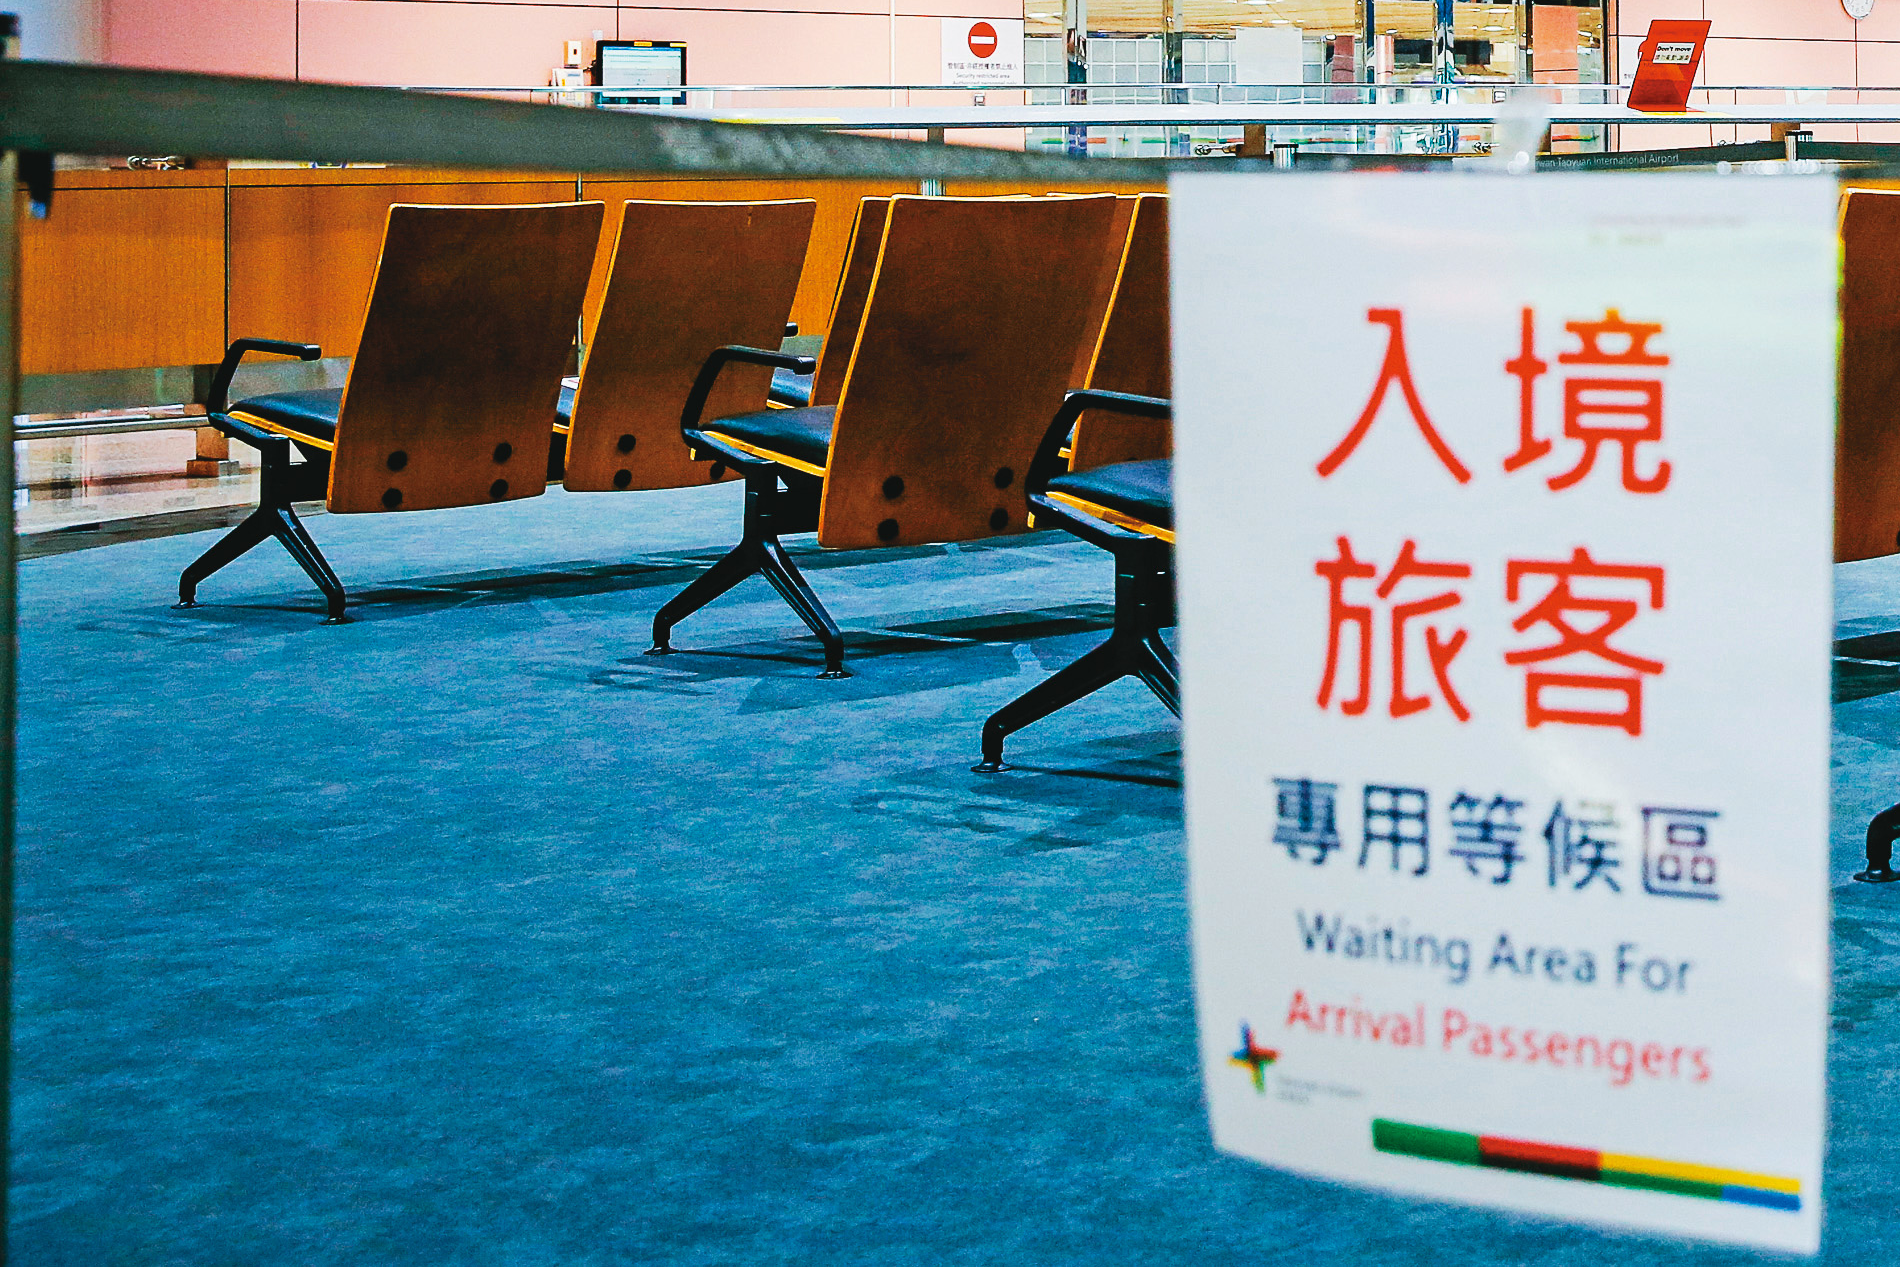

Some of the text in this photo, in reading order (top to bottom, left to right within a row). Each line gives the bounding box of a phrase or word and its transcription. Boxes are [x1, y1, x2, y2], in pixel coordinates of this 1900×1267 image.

[1594, 155, 1647, 165] International
[1650, 154, 1678, 163] Airport
[1317, 306, 1673, 495] 入境
[1315, 535, 1666, 737] 旅客
[1271, 775, 1723, 902] 專用等候區
[1297, 909, 1690, 994] Waiting Area For
[1285, 990, 1713, 1084] Arrival Passengers
